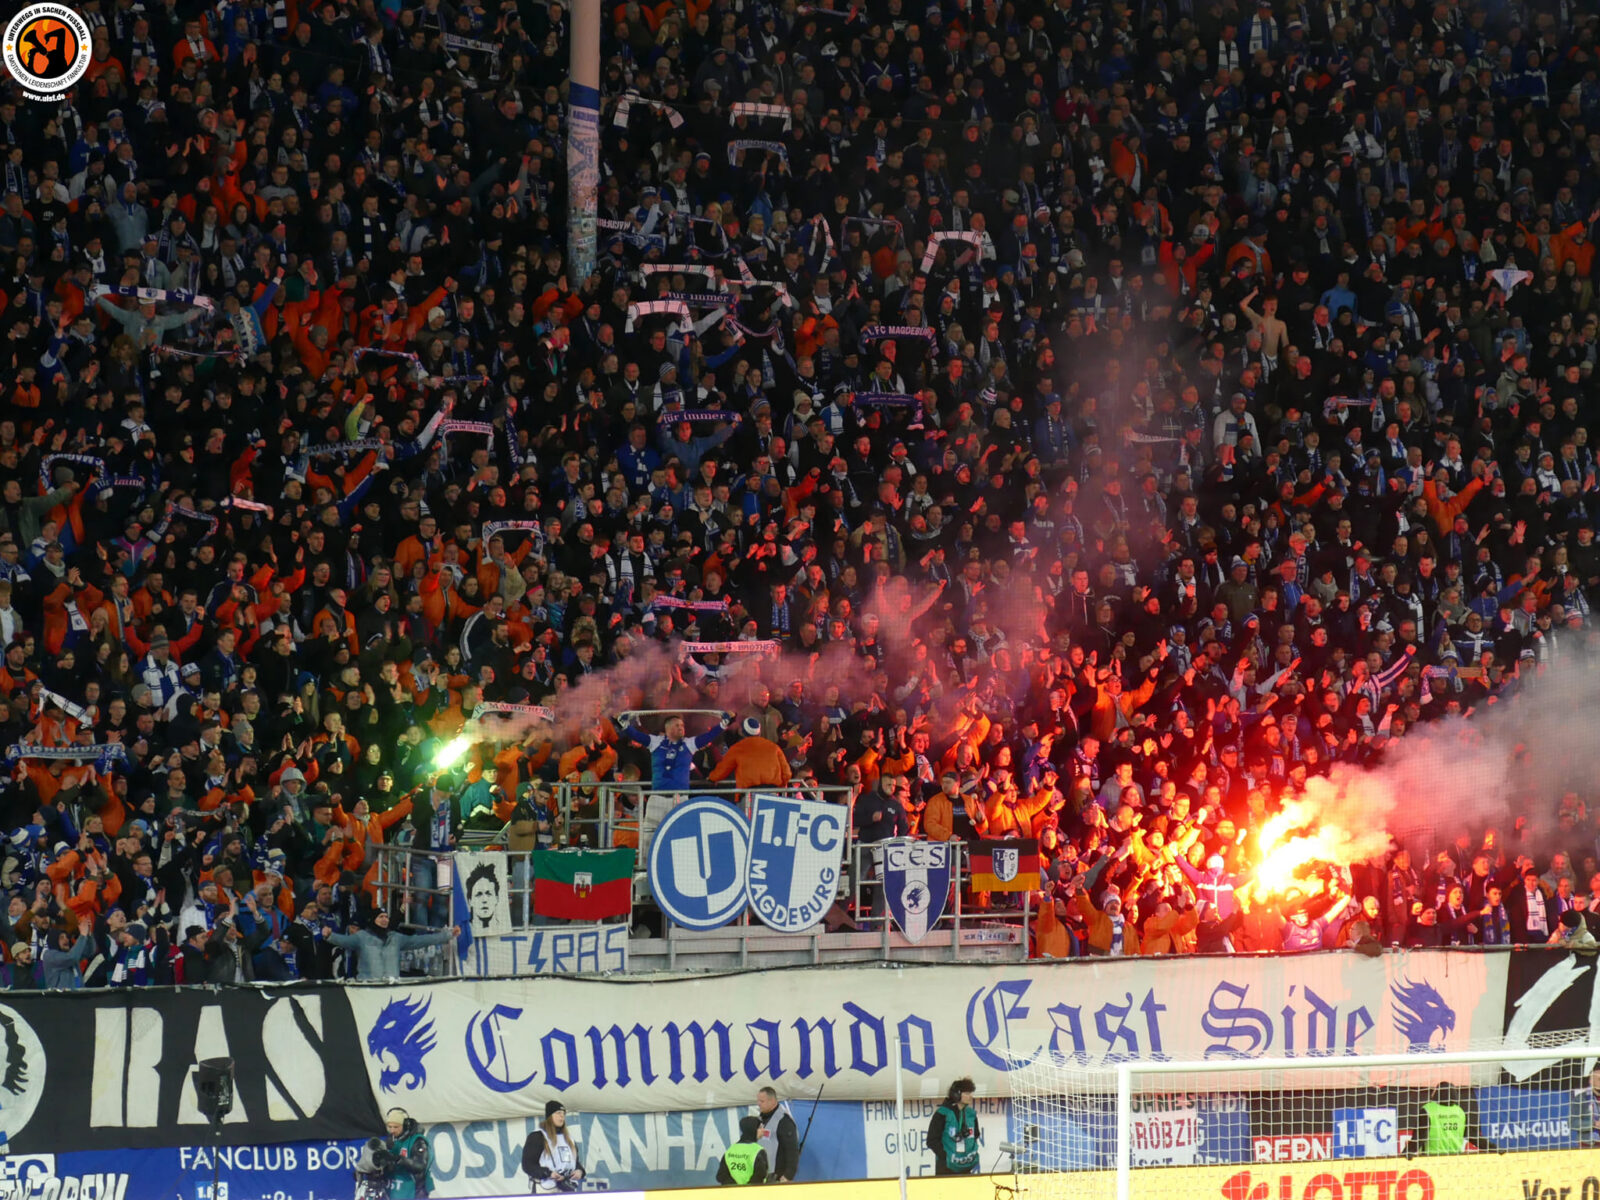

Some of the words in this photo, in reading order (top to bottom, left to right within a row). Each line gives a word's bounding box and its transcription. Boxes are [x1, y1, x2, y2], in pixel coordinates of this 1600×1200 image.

[874, 325, 887, 335] FC
[758, 808, 840, 852] 1.FC
[750, 858, 835, 926] MAGDEBURG
[464, 1001, 937, 1092] Commando
[966, 979, 1173, 1071] East
[1201, 980, 1375, 1060] Side
[1491, 1120, 1571, 1140] FAN-CLUB
[179, 1146, 298, 1171] FANCLUB
[307, 1140, 364, 1171] BÖR
[730, 1162, 747, 1171] 268
